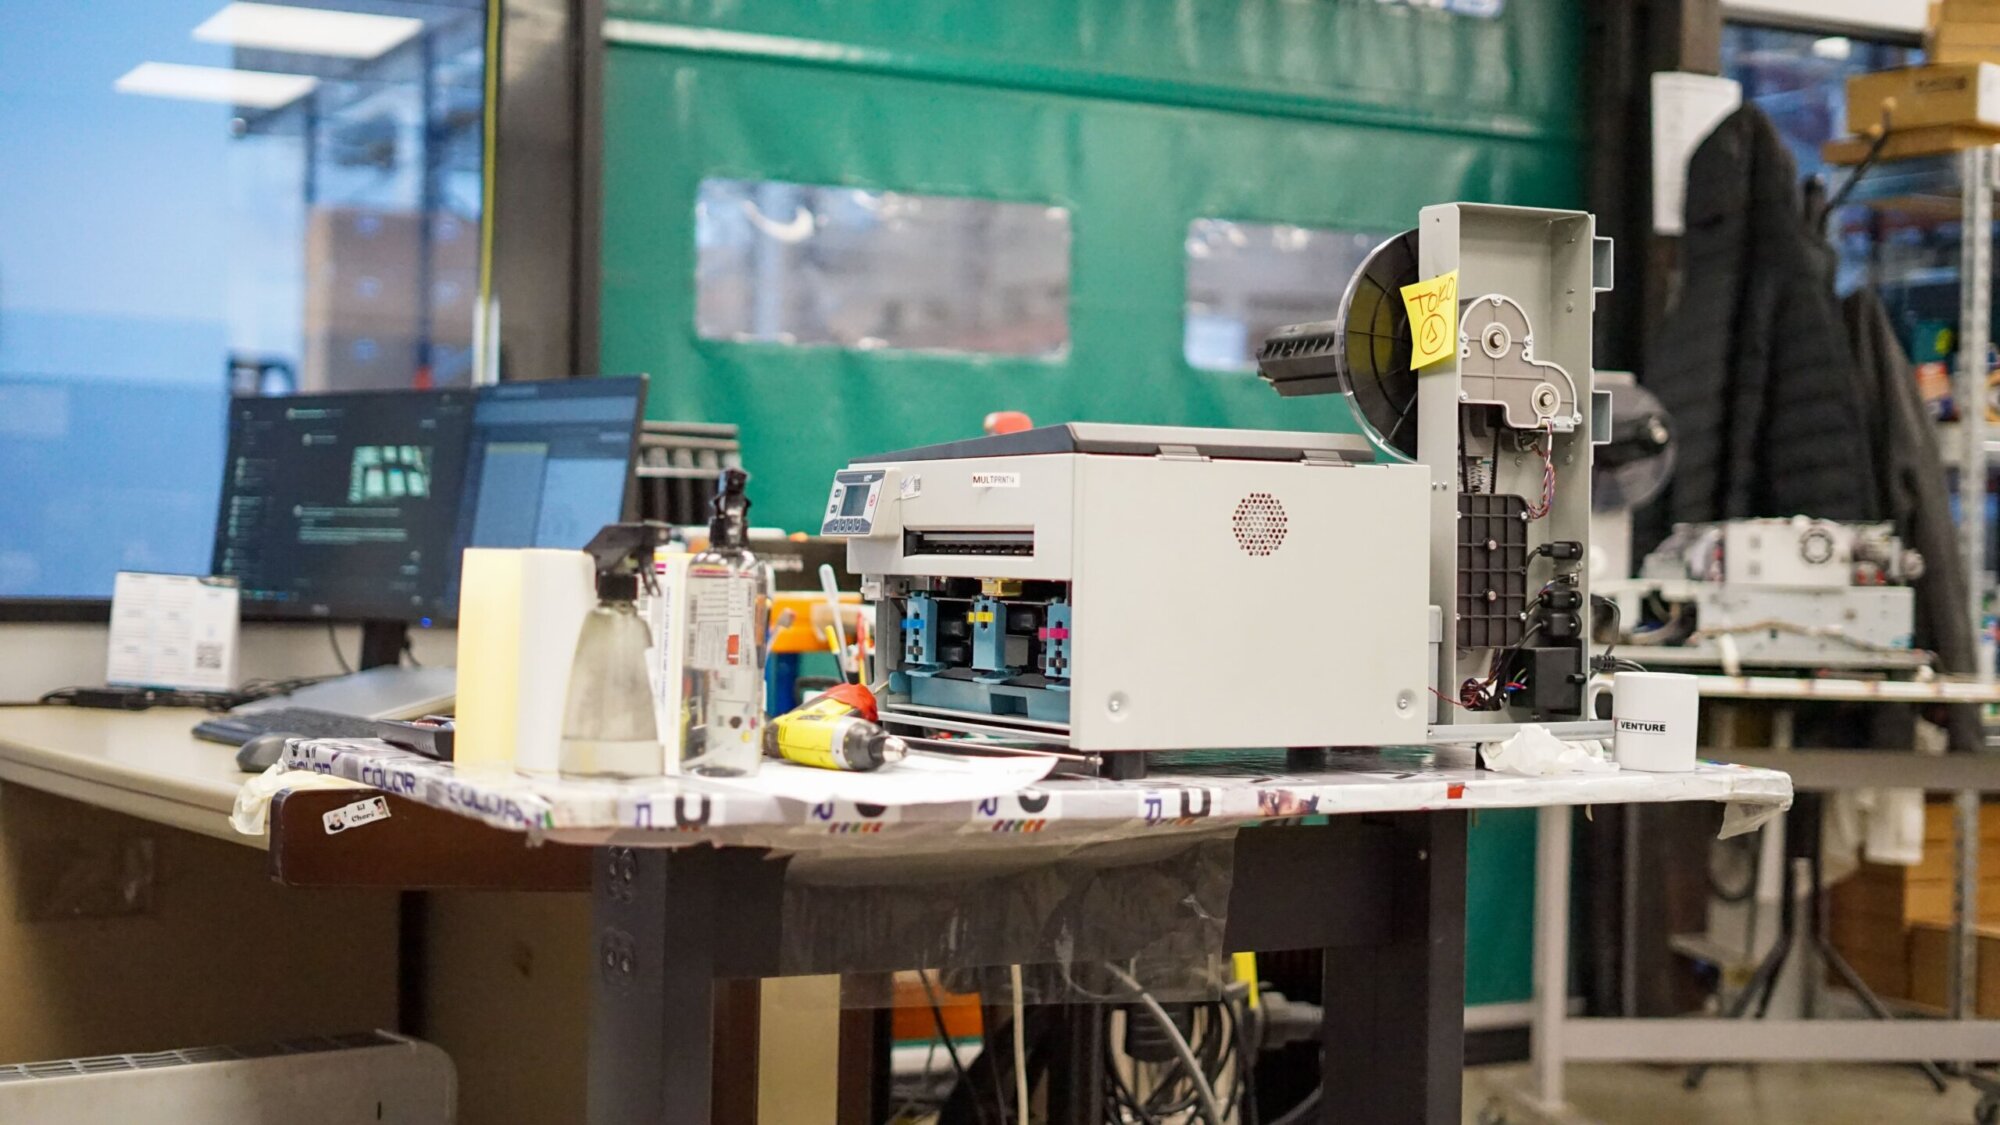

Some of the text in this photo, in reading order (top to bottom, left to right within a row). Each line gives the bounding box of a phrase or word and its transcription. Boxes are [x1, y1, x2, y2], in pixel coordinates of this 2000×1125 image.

[1409, 277, 1455, 316] TOKO
[1620, 721, 1666, 732] VENTURE
[361, 765, 416, 794] COLOR
